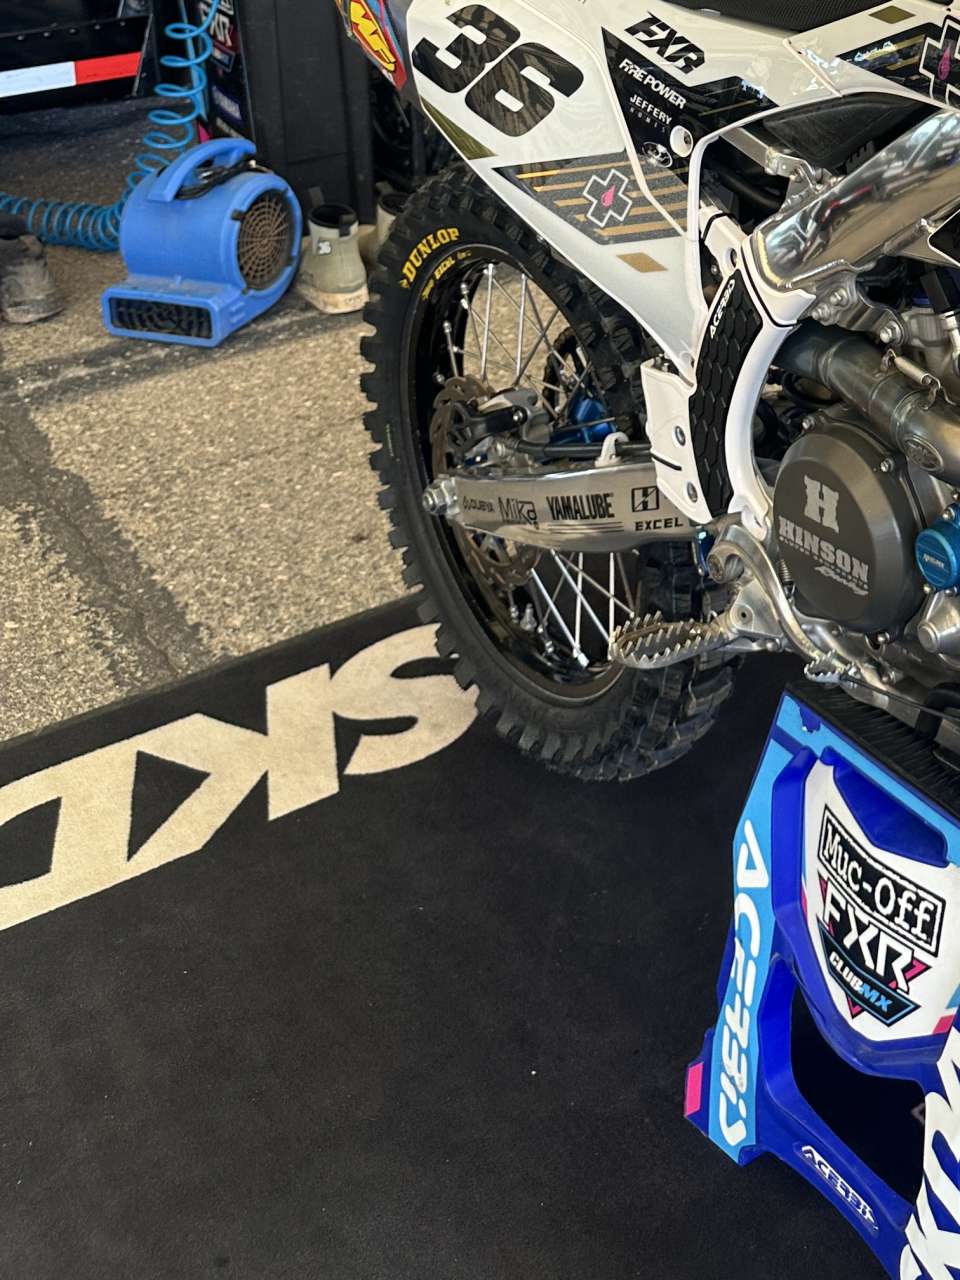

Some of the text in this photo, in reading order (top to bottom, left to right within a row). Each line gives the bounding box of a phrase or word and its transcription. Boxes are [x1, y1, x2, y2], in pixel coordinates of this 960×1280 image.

[411, 4, 585, 138] 36
[624, 11, 706, 74] FXR
[629, 93, 672, 125] JEFFERY
[643, 74, 687, 111] POWER
[402, 227, 460, 283] DUNLOP
[546, 493, 616, 521] YAMALUBE
[634, 517, 684, 532] EXCEL
[778, 517, 870, 584] HINSON
[824, 823, 934, 941] Muc-Off
[824, 877, 915, 993] FXR
[718, 819, 776, 1147] ACERBIS
[829, 950, 893, 1012] CLUBMX
